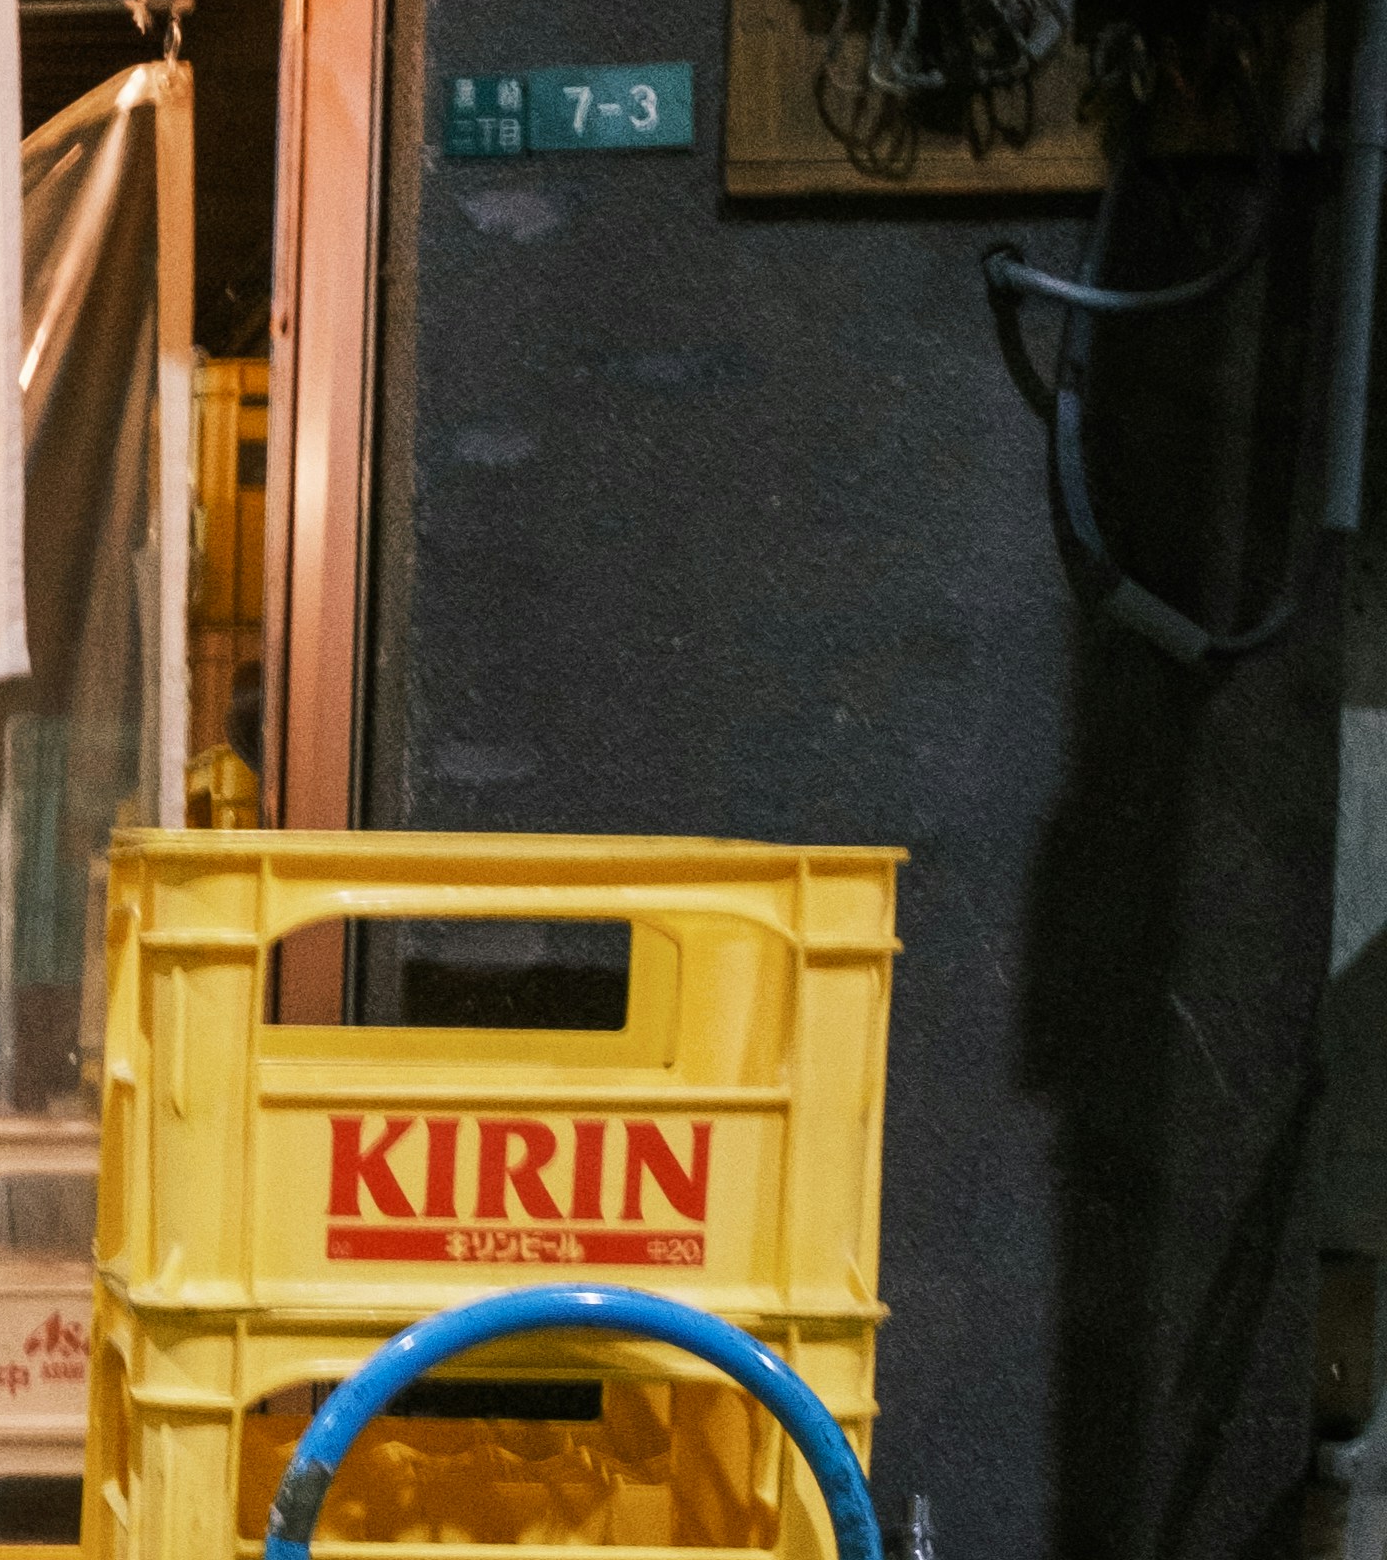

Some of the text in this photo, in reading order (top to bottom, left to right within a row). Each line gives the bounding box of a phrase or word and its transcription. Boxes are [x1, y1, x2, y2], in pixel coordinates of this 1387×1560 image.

[562, 83, 658, 137] 7-3
[325, 1114, 713, 1223] KIRIN
[444, 1228, 586, 1263] キリンビール
